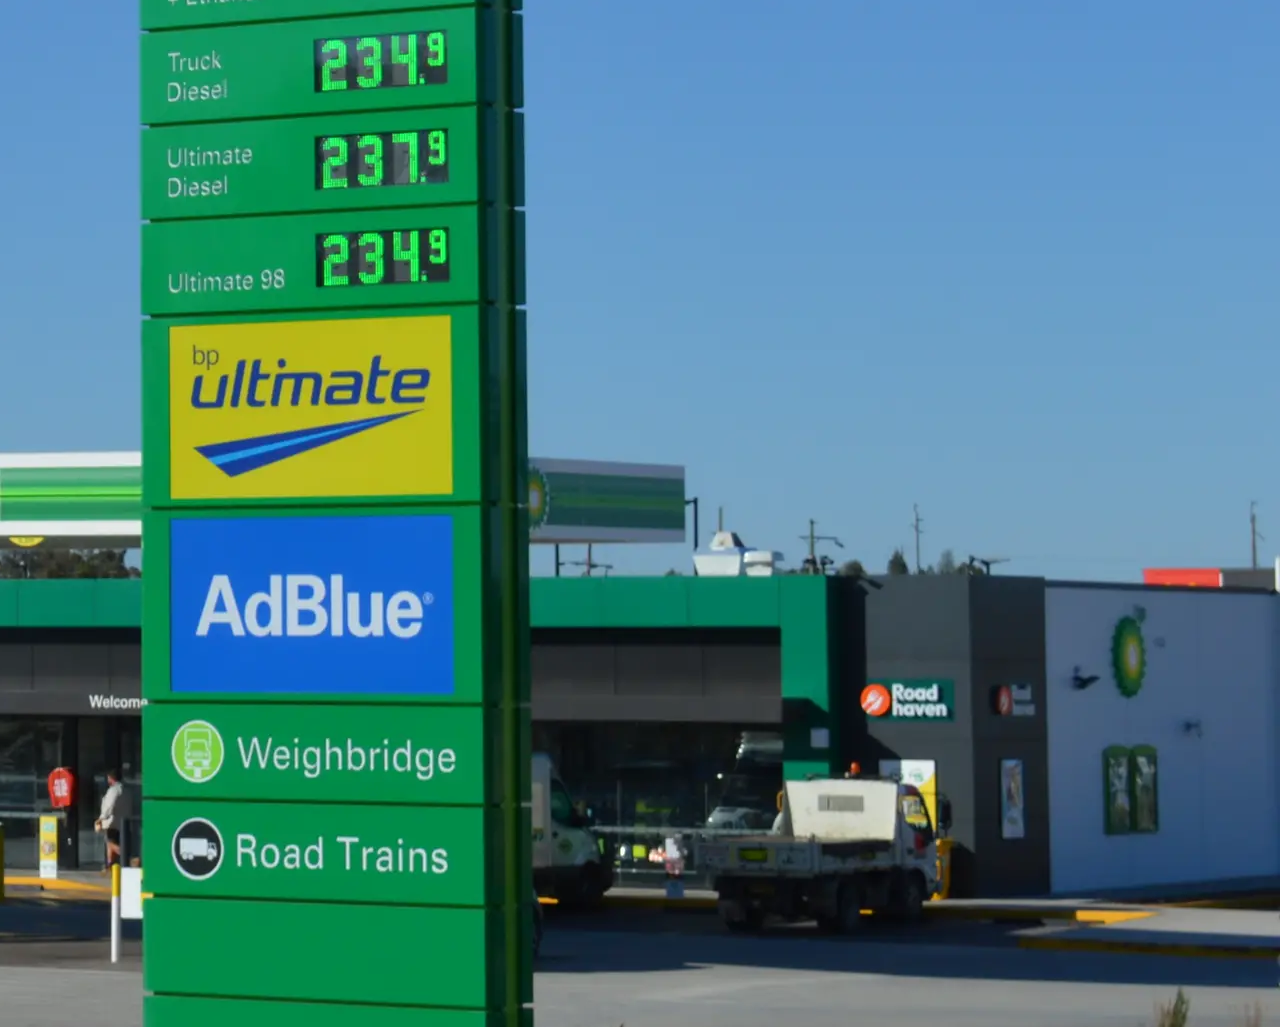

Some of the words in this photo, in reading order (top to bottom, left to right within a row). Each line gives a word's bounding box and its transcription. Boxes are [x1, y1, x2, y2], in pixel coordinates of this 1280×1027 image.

[168, 50, 222, 73] Truck
[167, 79, 228, 102] Diesel
[167, 146, 253, 169] Ultimate
[167, 176, 228, 198] Diesel
[168, 271, 253, 294] Ultimate
[261, 268, 285, 289] 98
[192, 345, 220, 370] bp
[191, 355, 431, 409] ultimate
[89, 694, 149, 709] Welcome
[892, 683, 939, 701] Road
[892, 701, 948, 717] haven
[237, 736, 456, 780] Weighbridge
[237, 833, 324, 869] Road
[336, 836, 449, 874] Trains
